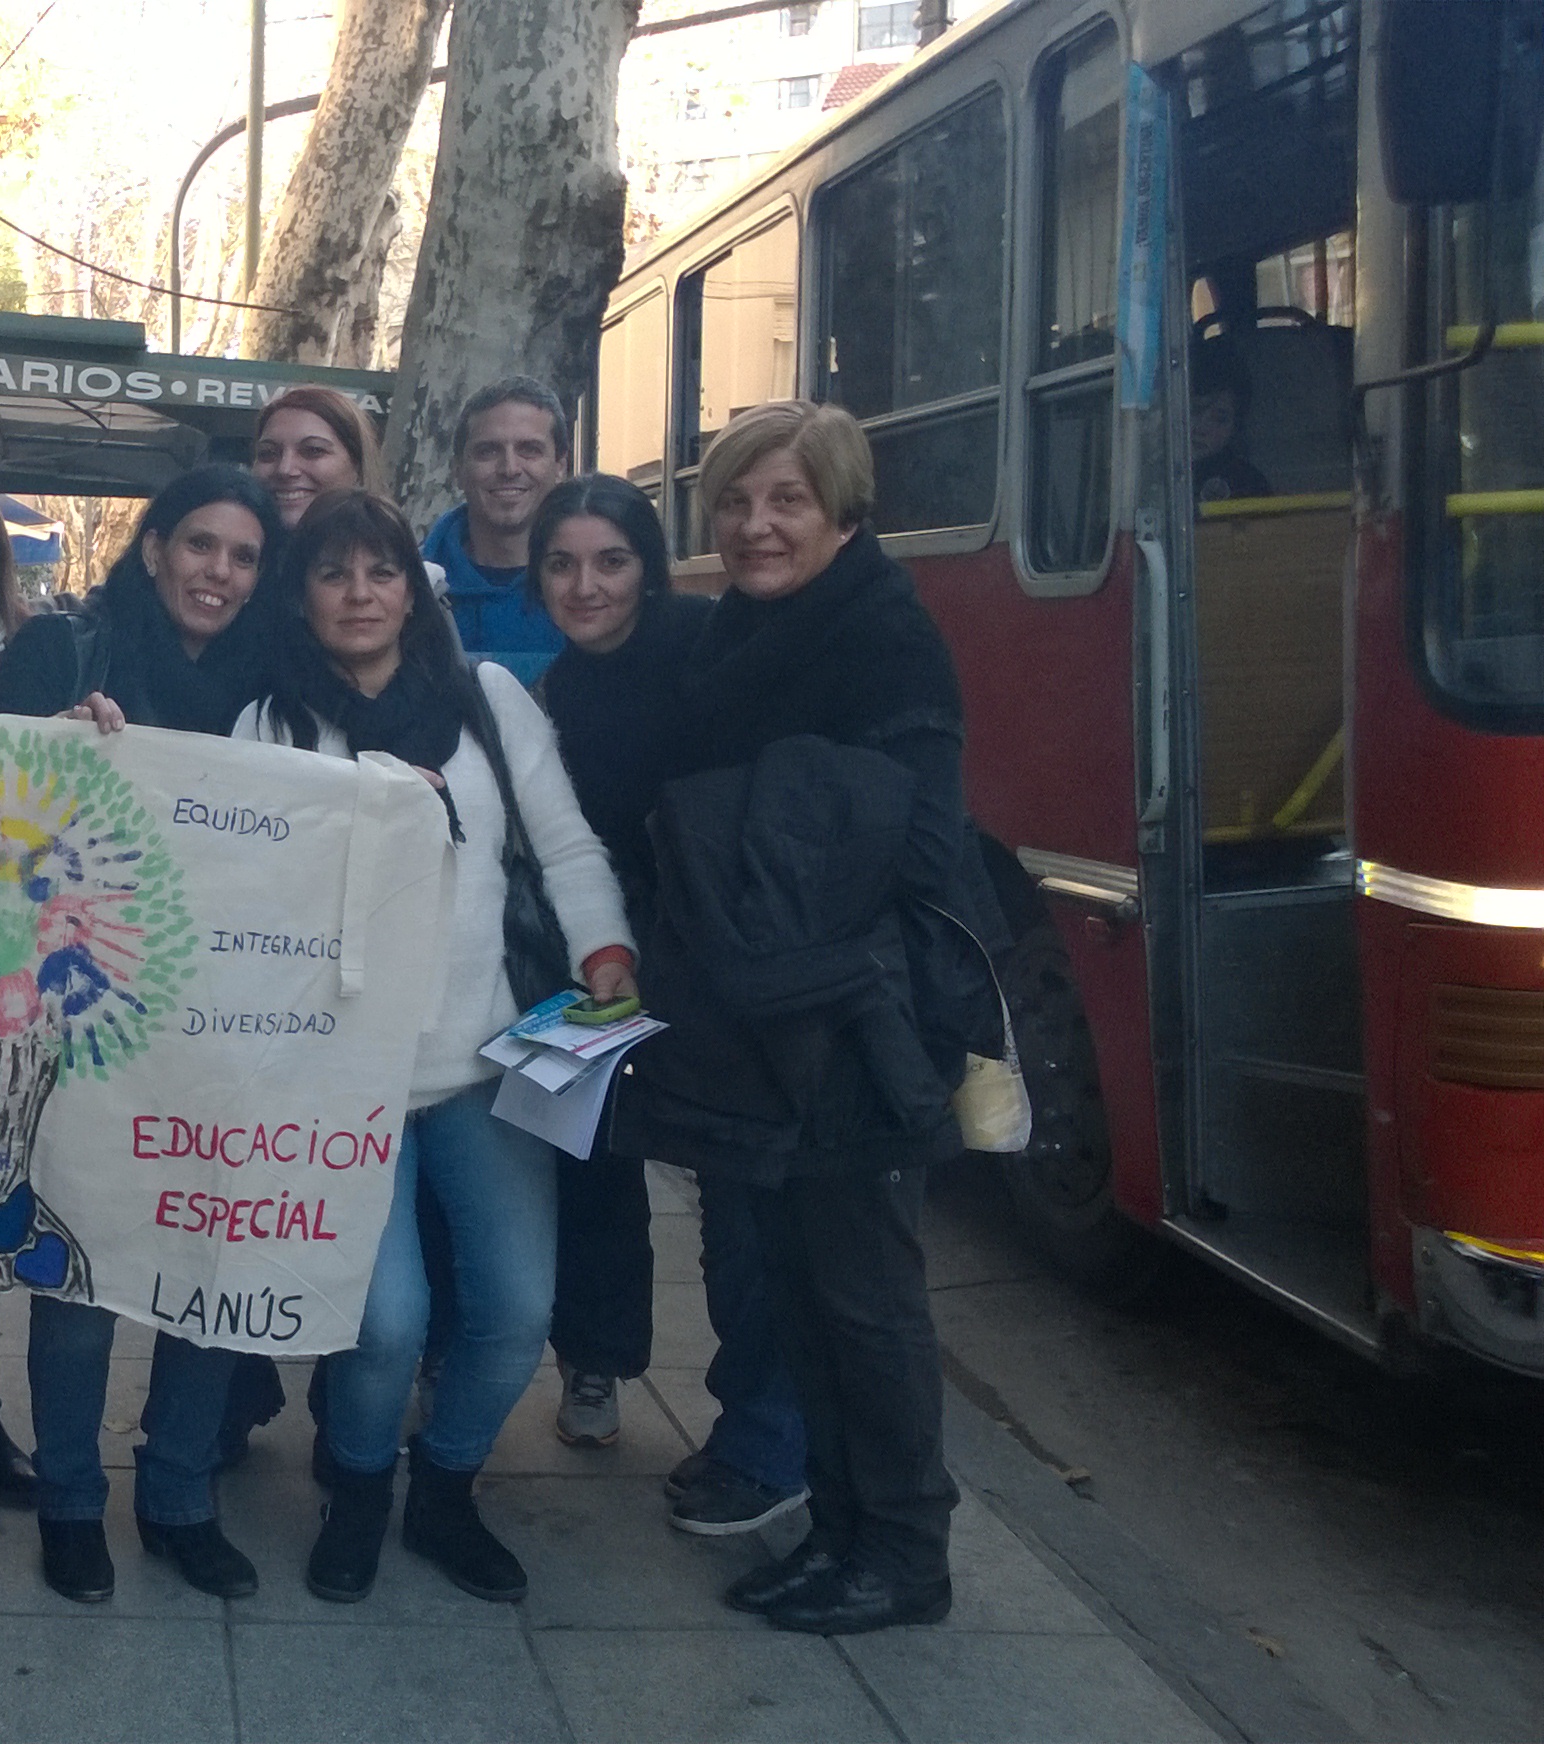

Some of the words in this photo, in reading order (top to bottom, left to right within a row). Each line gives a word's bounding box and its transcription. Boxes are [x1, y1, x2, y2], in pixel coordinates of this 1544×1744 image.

[173, 799, 290, 842] EQUIDAD
[210, 929, 344, 960] INTEGRACIÓ
[156, 1190, 338, 1242] ESPECIAL
[150, 1271, 303, 1341] LANÚS
